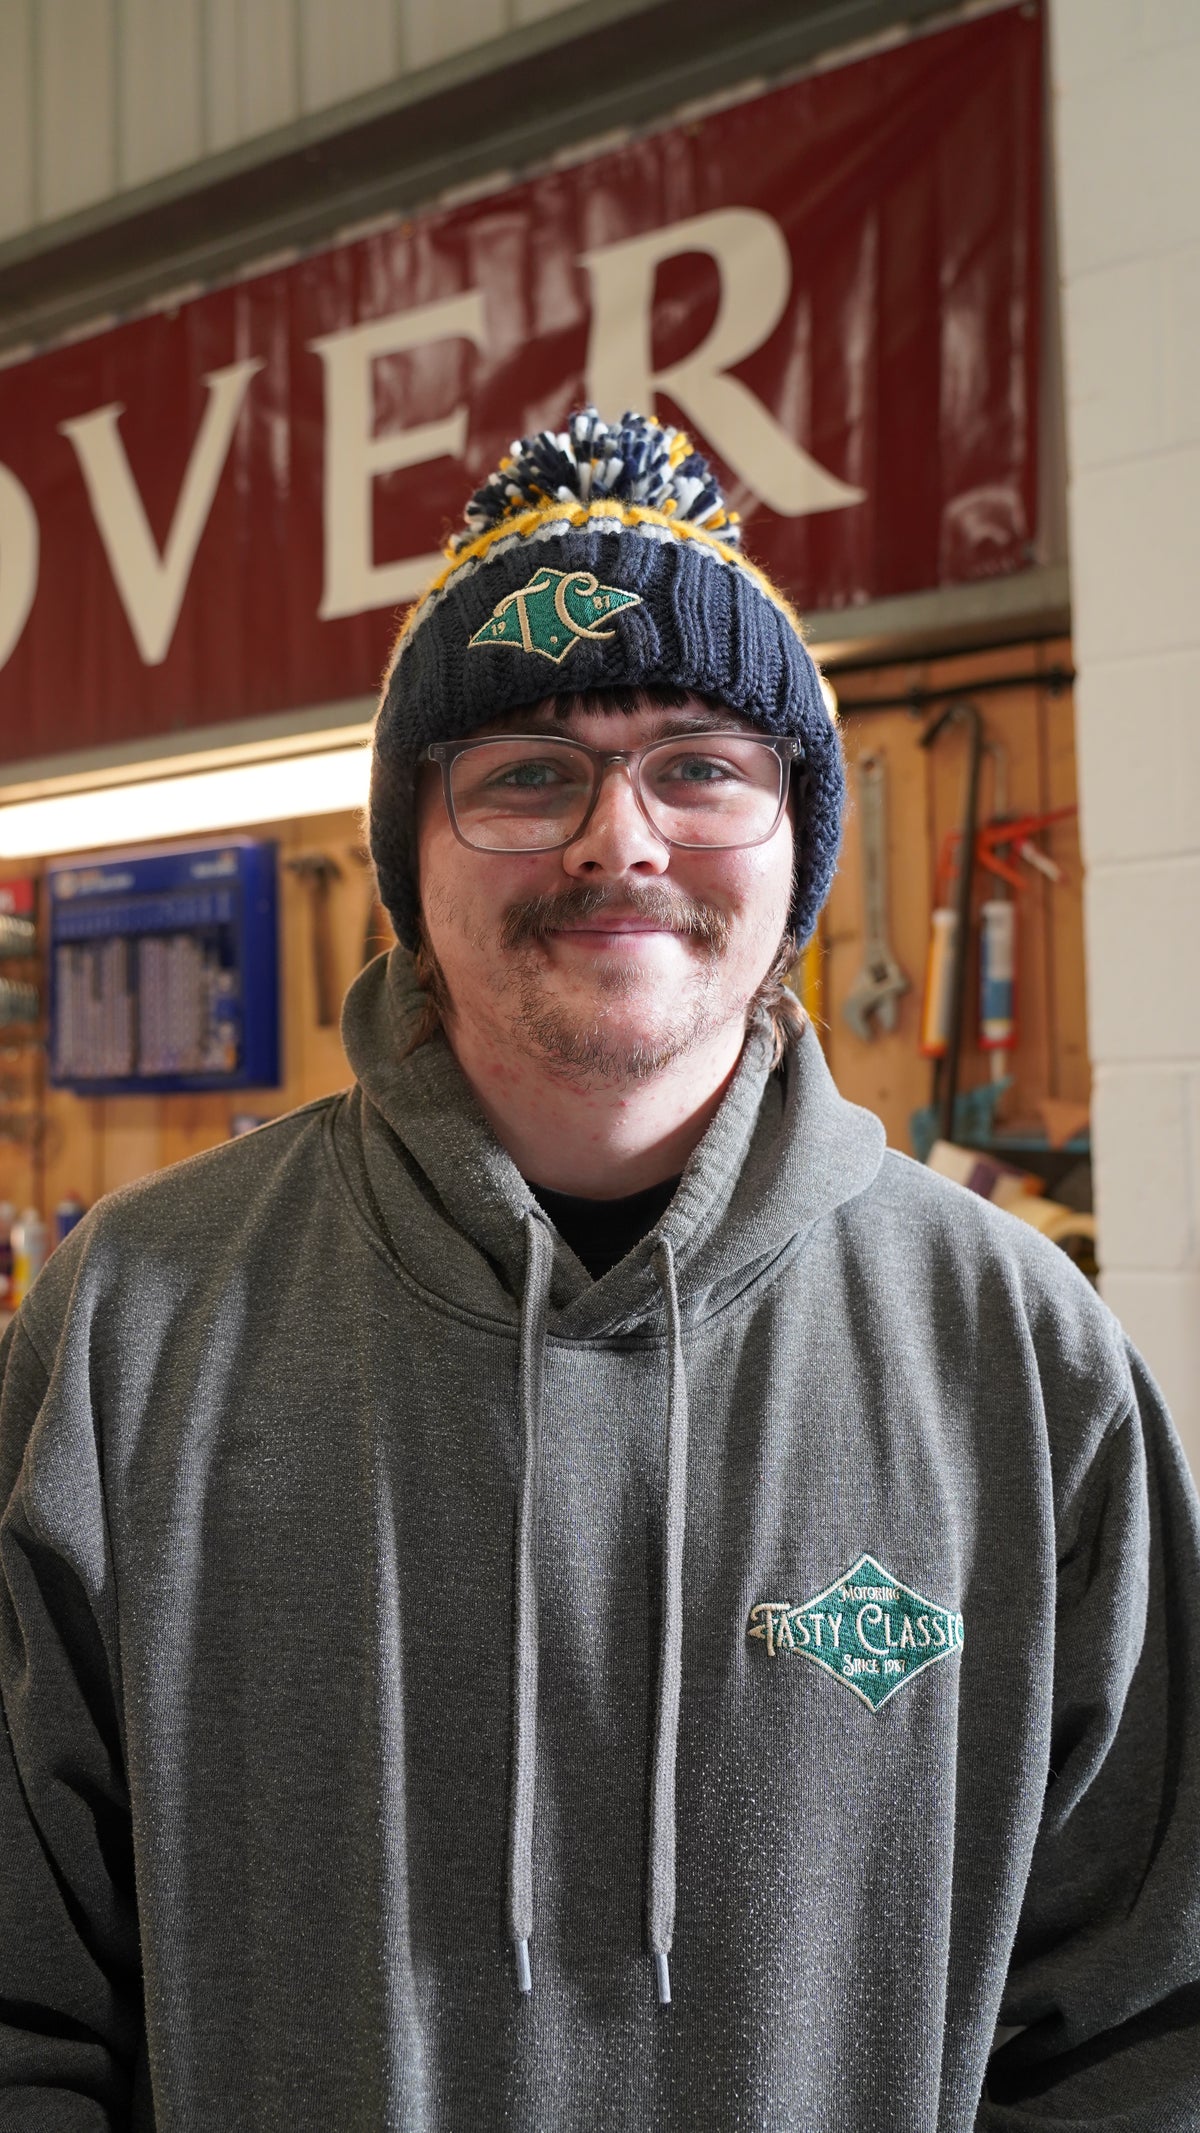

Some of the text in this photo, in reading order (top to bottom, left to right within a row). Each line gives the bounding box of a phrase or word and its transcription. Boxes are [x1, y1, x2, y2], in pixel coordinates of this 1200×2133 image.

[0, 206, 866, 672] VER
[491, 621, 507, 636] 19
[839, 1585, 900, 1603] MOTORING
[751, 1602, 843, 1657] TASTY
[843, 1653, 906, 1676] SINCE 1987
